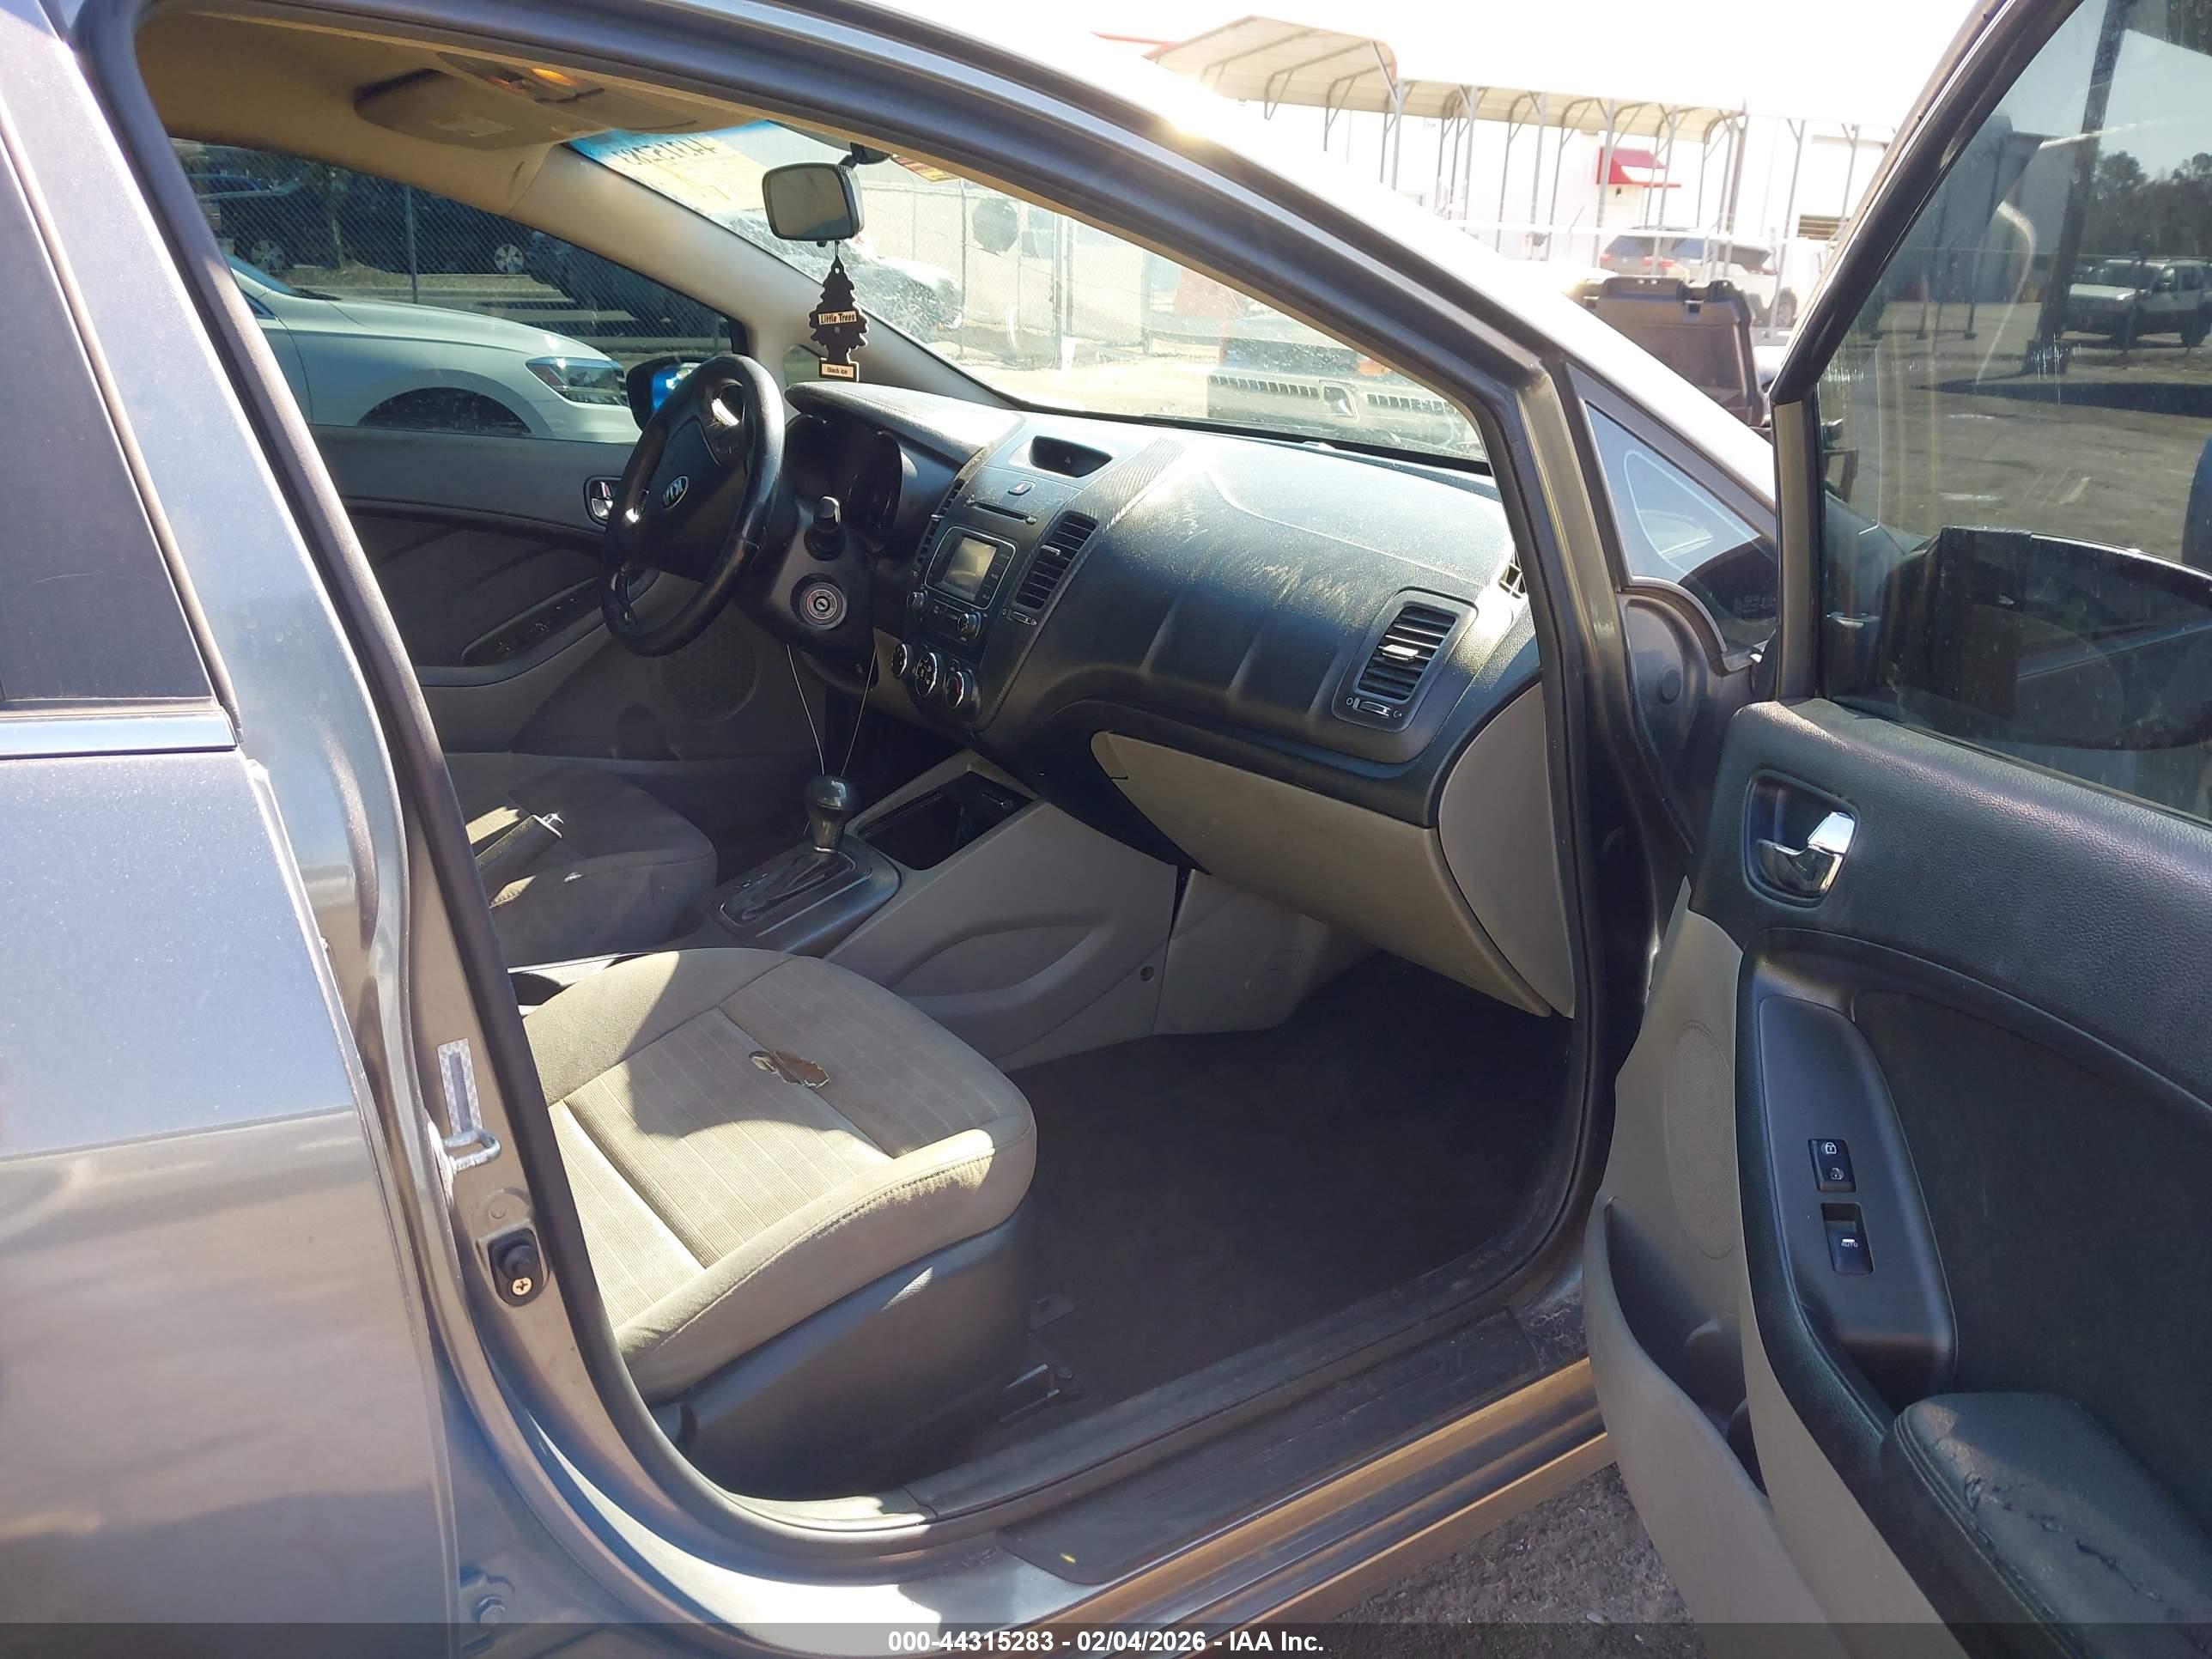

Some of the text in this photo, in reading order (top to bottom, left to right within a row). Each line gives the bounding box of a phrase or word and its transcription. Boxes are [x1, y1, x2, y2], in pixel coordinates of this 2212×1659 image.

[821, 313, 855, 324] Little Trees
[827, 366, 840, 374] Black
[662, 478, 684, 506] KIA
